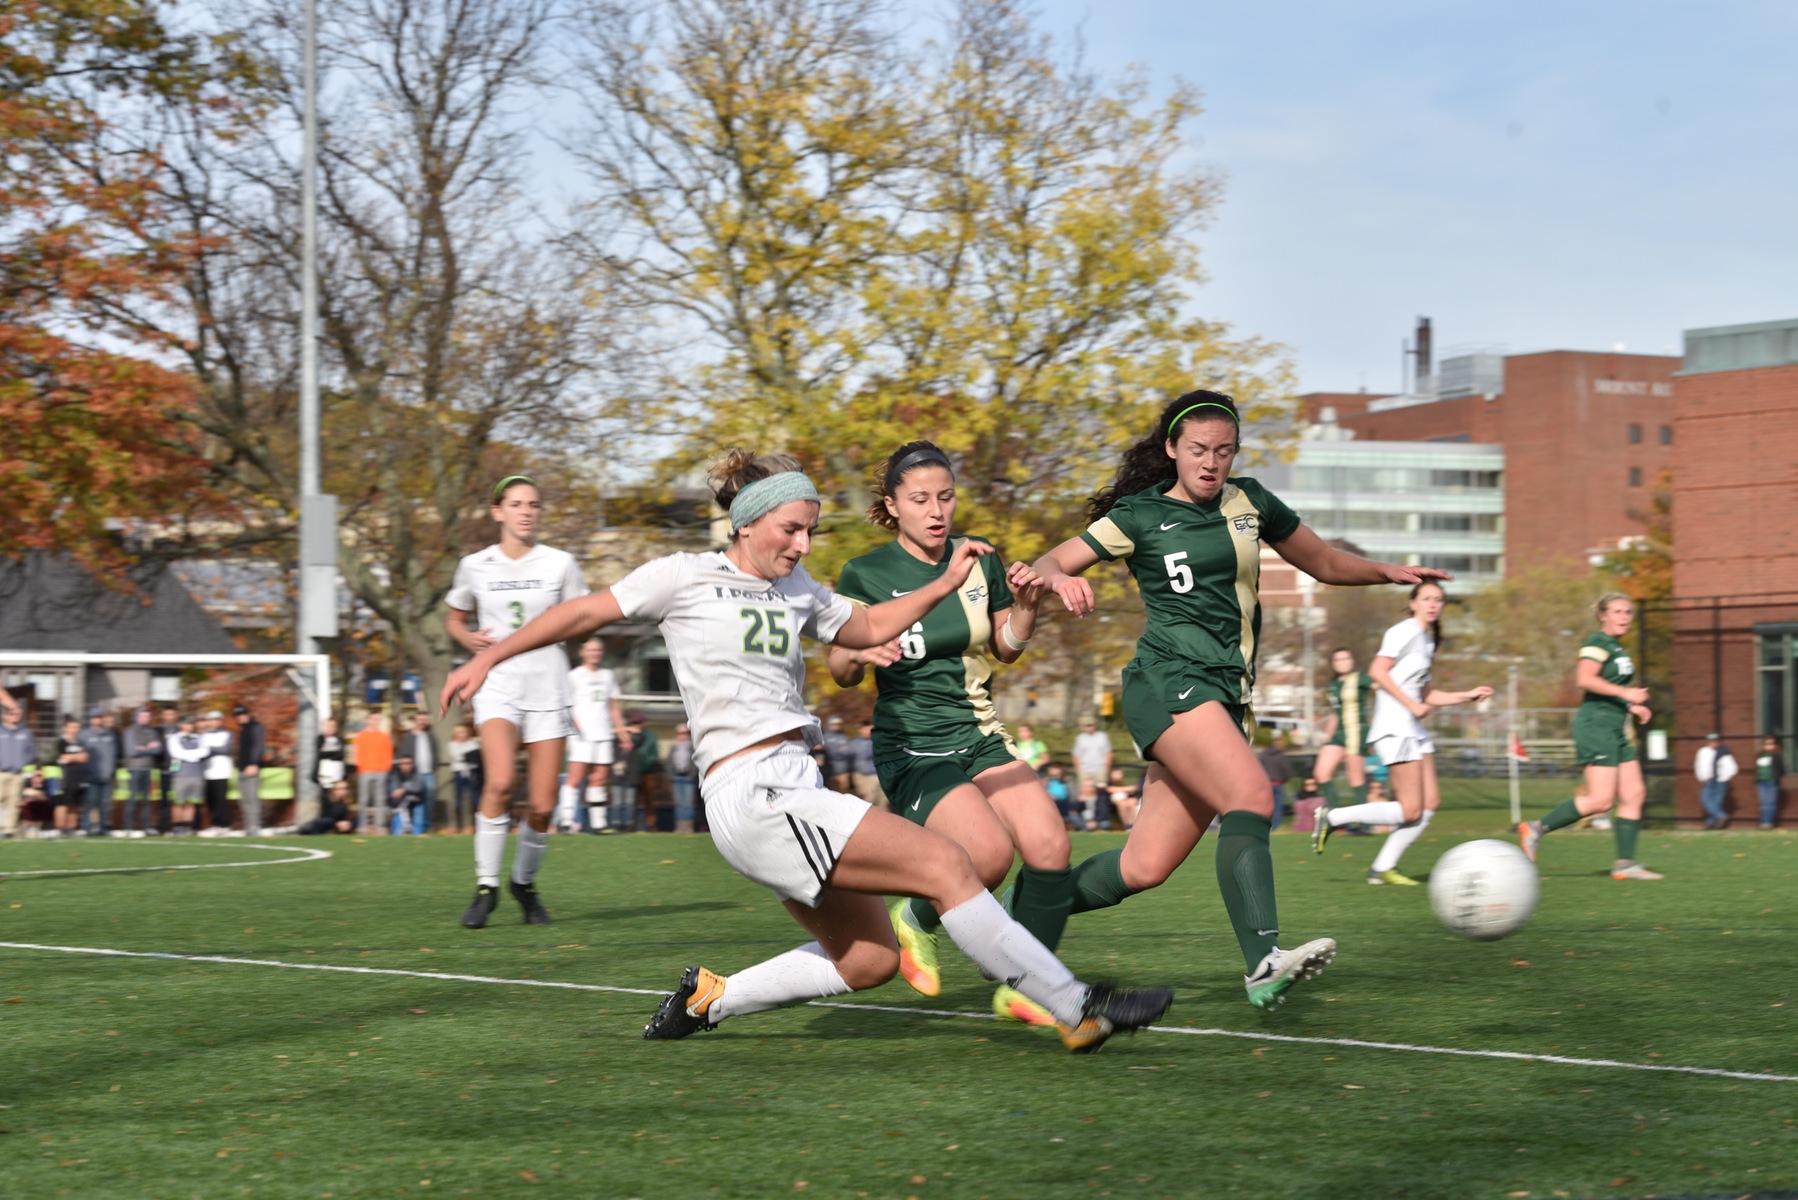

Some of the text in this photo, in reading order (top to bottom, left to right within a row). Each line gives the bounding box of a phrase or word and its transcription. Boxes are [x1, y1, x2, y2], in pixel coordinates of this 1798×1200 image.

[1163, 550, 1195, 594] 5
[507, 600, 526, 630] 3
[740, 607, 790, 657] 25
[899, 620, 927, 660] 6
